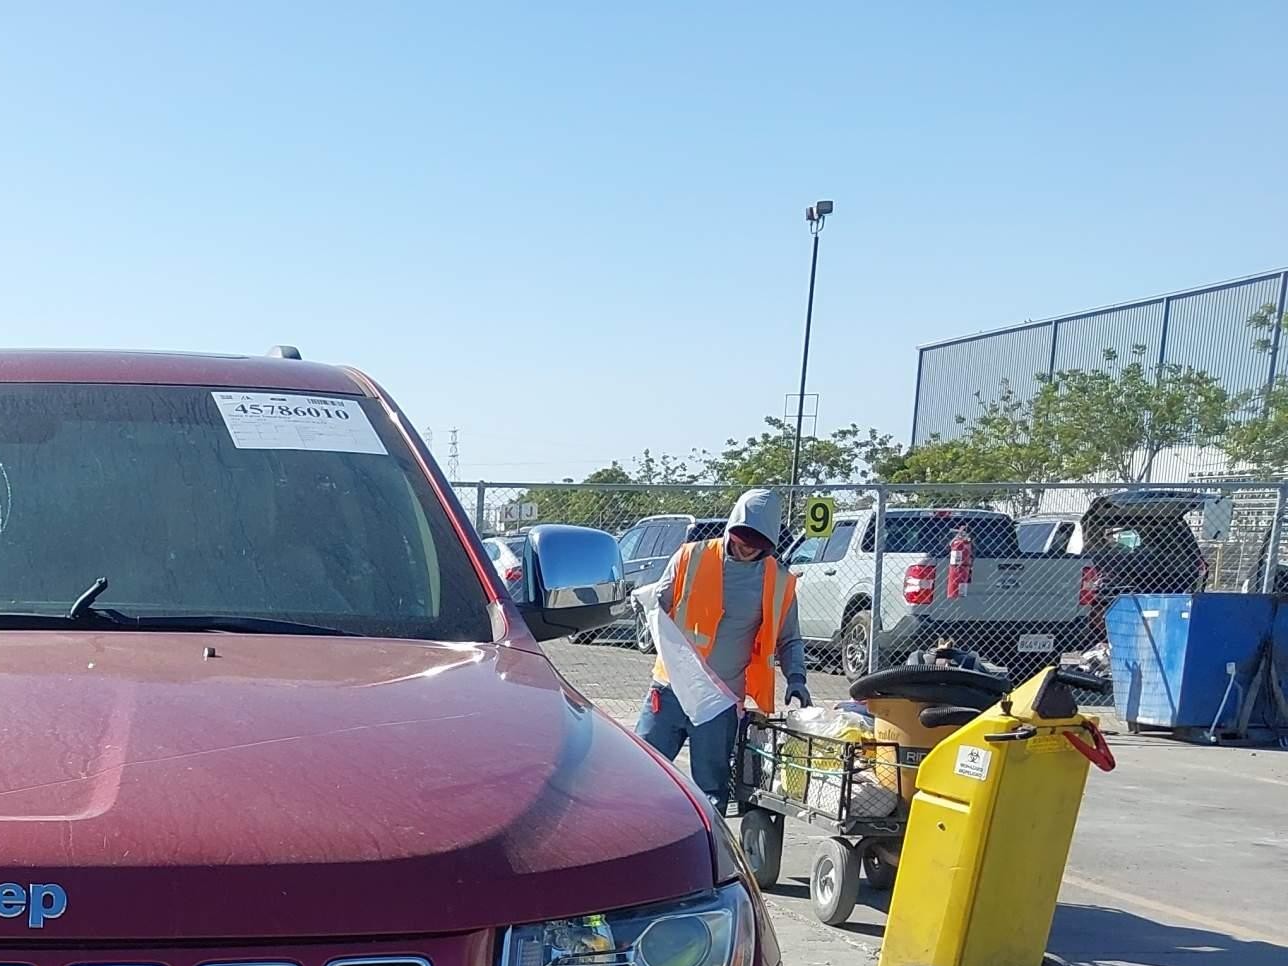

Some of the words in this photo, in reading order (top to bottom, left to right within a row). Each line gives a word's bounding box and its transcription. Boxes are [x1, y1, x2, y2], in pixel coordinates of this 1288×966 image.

[235, 403, 349, 420] 45786010
[504, 506, 514, 518] K
[810, 502, 830, 533] 9
